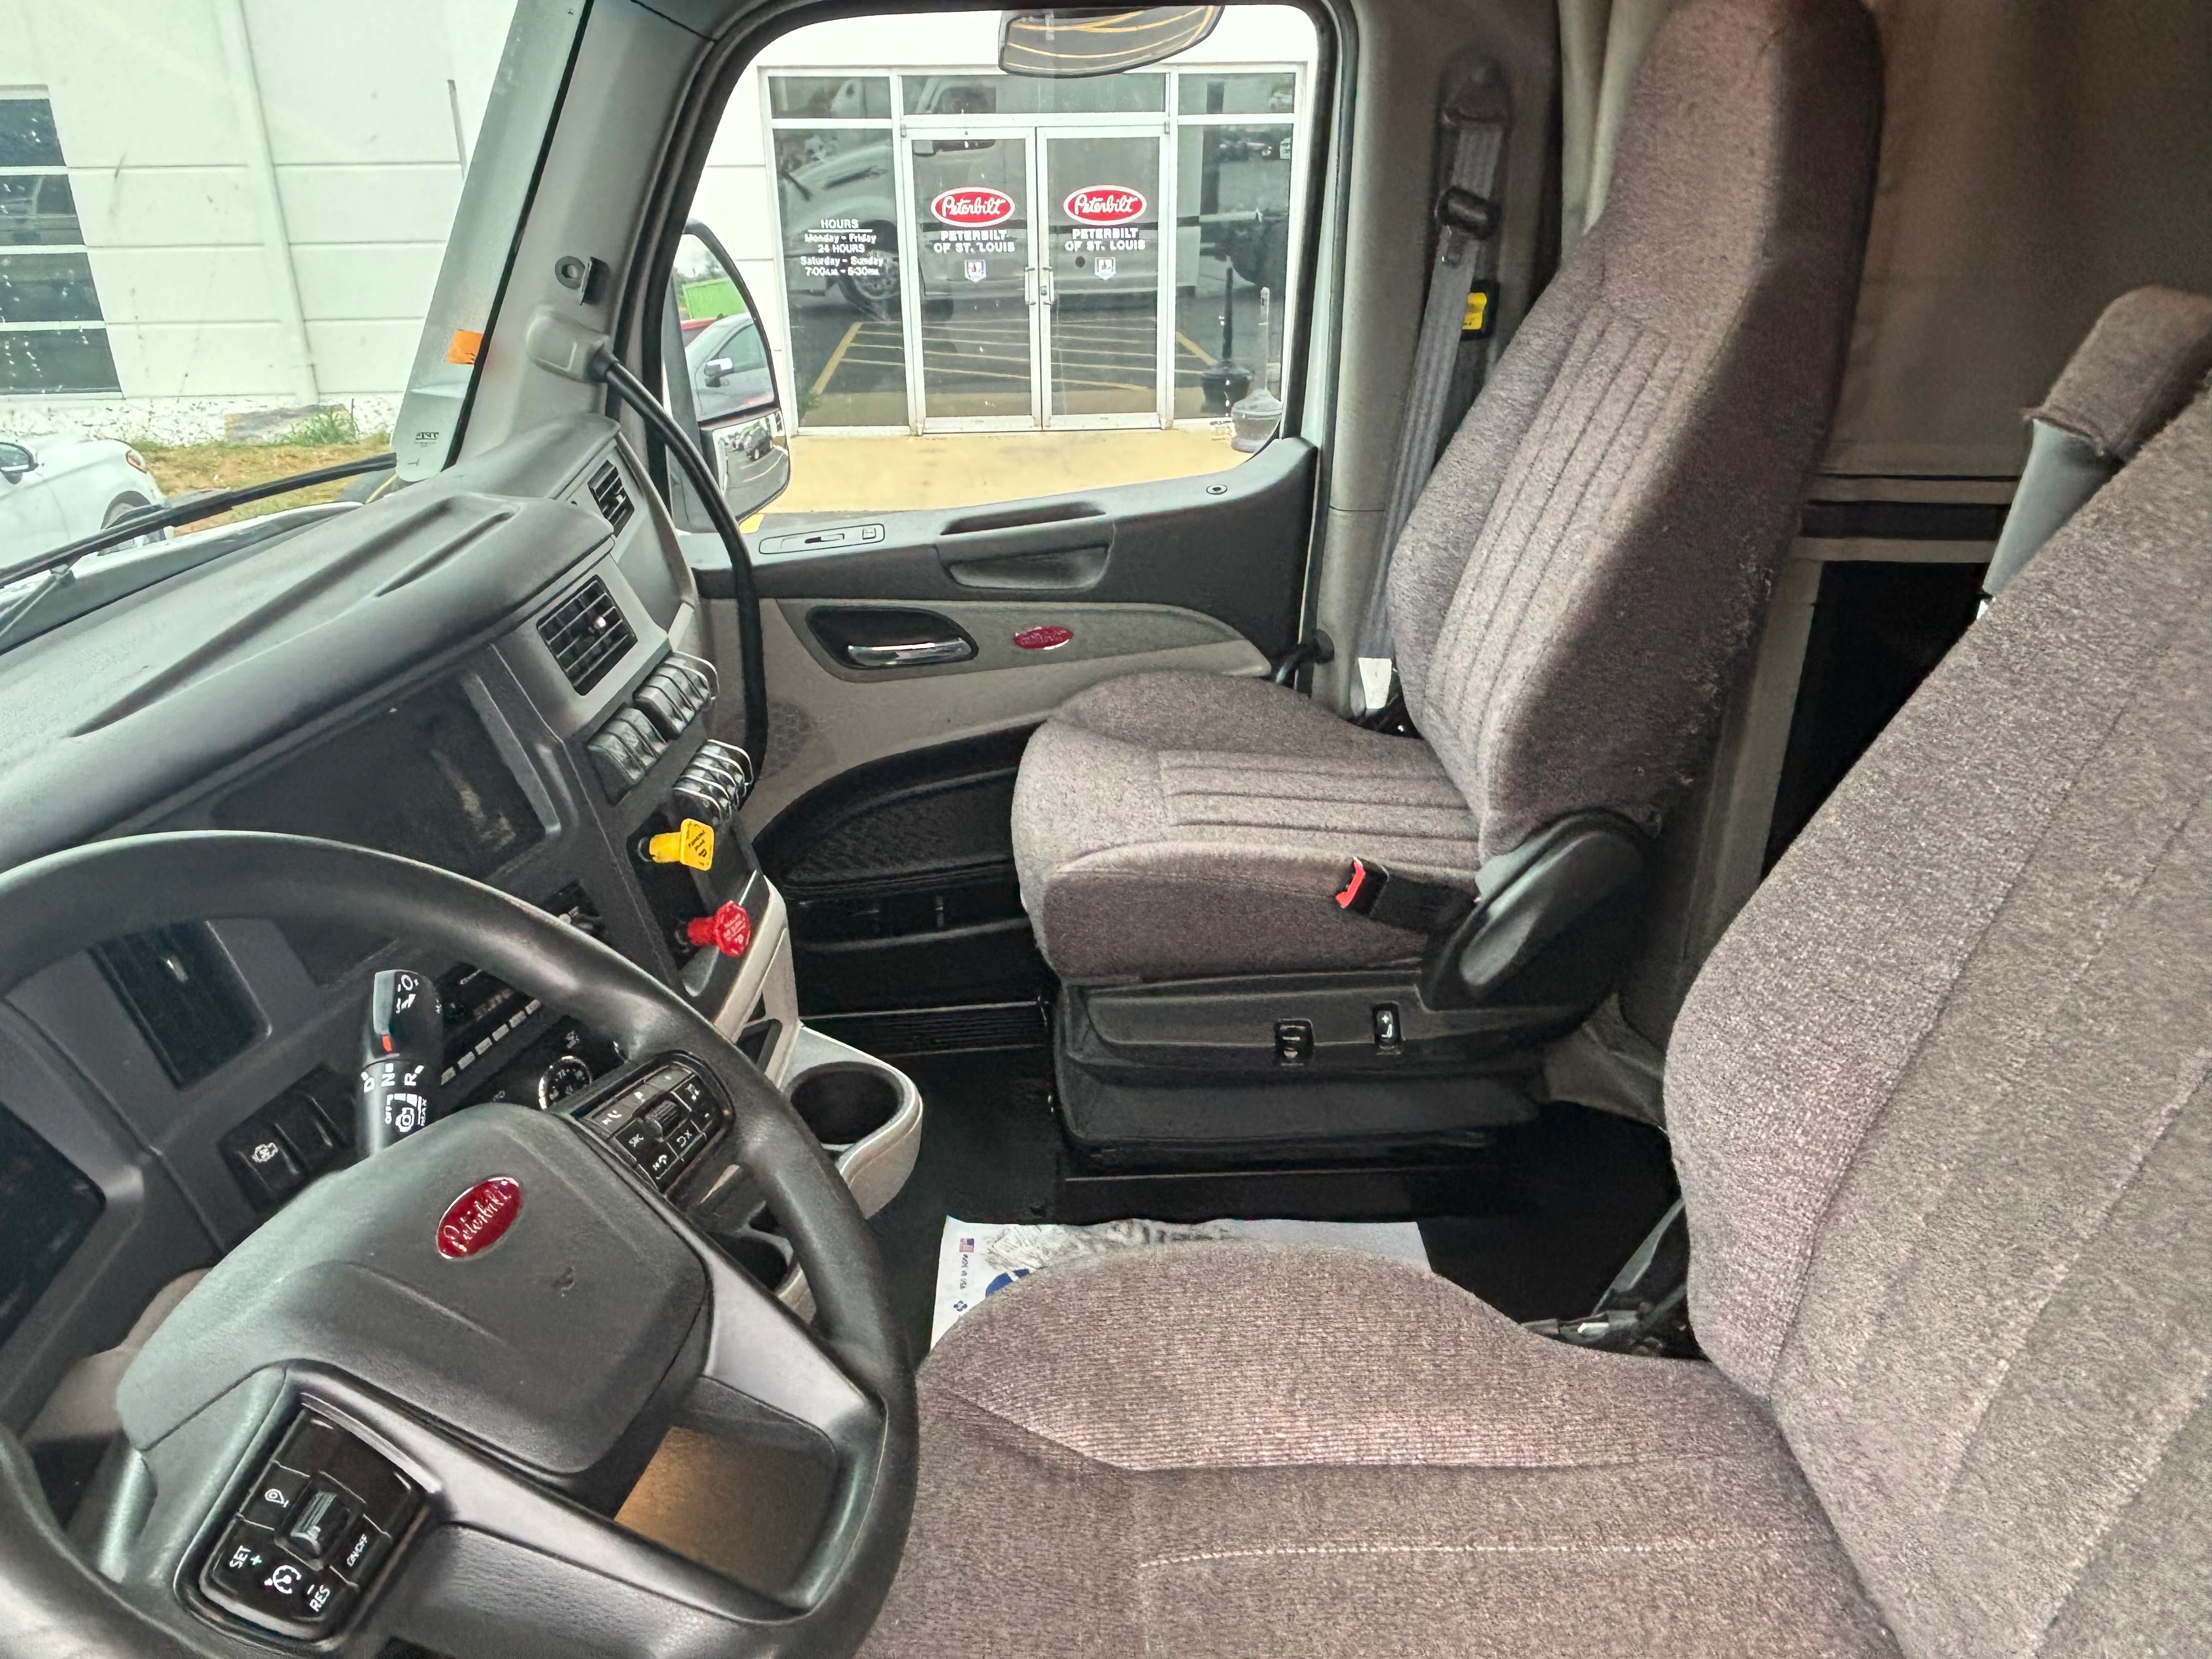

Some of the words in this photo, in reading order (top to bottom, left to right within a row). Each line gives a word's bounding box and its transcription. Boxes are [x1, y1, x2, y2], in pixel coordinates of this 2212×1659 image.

[941, 195, 1007, 217] Peterbilt
[1074, 193, 1138, 216] Peterbilt
[820, 219, 859, 229] HOURS
[804, 233, 840, 244] Monday
[849, 233, 877, 244] Friday
[940, 229, 1007, 241] PETERBILT
[1072, 227, 1139, 240] PETERBILT
[817, 244, 830, 253] 24
[832, 244, 865, 254] HOURS
[933, 242, 951, 254] OF
[955, 242, 975, 253] ST.
[975, 241, 1015, 253] LOUIS
[1064, 240, 1082, 252] OF
[1086, 240, 1105, 251] ST.
[1109, 239, 1146, 251] LOUIS
[800, 256, 840, 267] Saturday
[850, 256, 884, 267] Sunday
[364, 1077, 375, 1093] D
[381, 1073, 396, 1087] N
[404, 1073, 417, 1086] R
[229, 1545, 251, 1569] SET
[309, 1584, 331, 1612] RES
